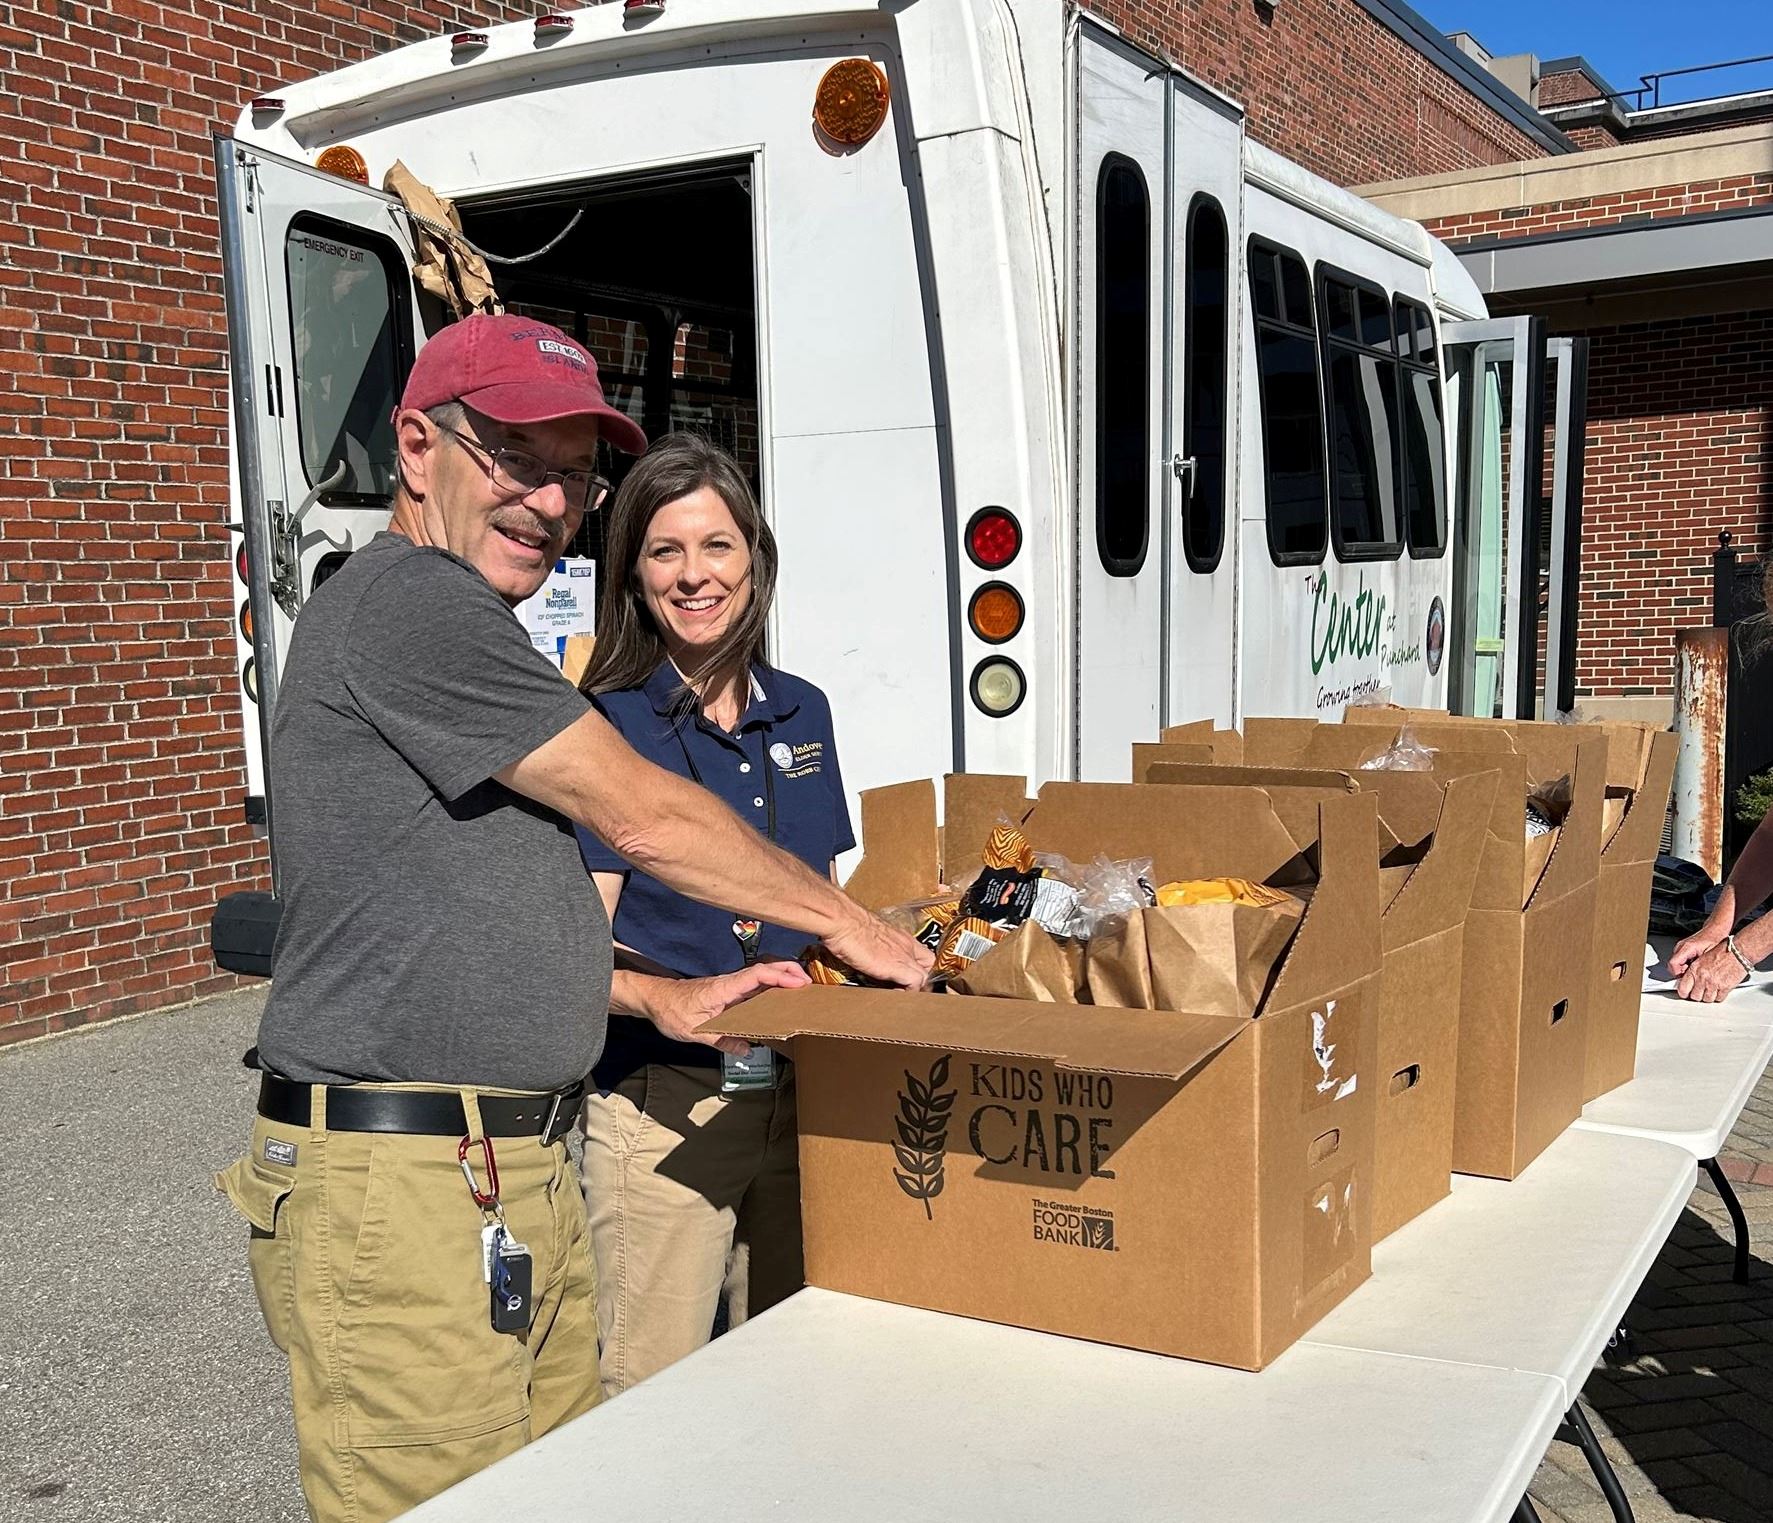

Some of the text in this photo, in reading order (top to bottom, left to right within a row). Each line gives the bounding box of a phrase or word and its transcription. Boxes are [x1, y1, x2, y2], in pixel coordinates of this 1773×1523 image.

[303, 237, 364, 262] EMERGENCY EXIT
[552, 588, 571, 600] Regal
[1311, 568, 1386, 676] Center
[1386, 615, 1397, 632] at
[1381, 635, 1421, 672] Punchard
[1316, 680, 1350, 709] Growing
[968, 1063, 1113, 1110] KIDS WHO
[968, 1104, 1116, 1180] CARE
[1032, 1198, 1114, 1218] The Greater Boston
[1033, 1209, 1080, 1229] FOOD
[1033, 1225, 1081, 1247] BANK
